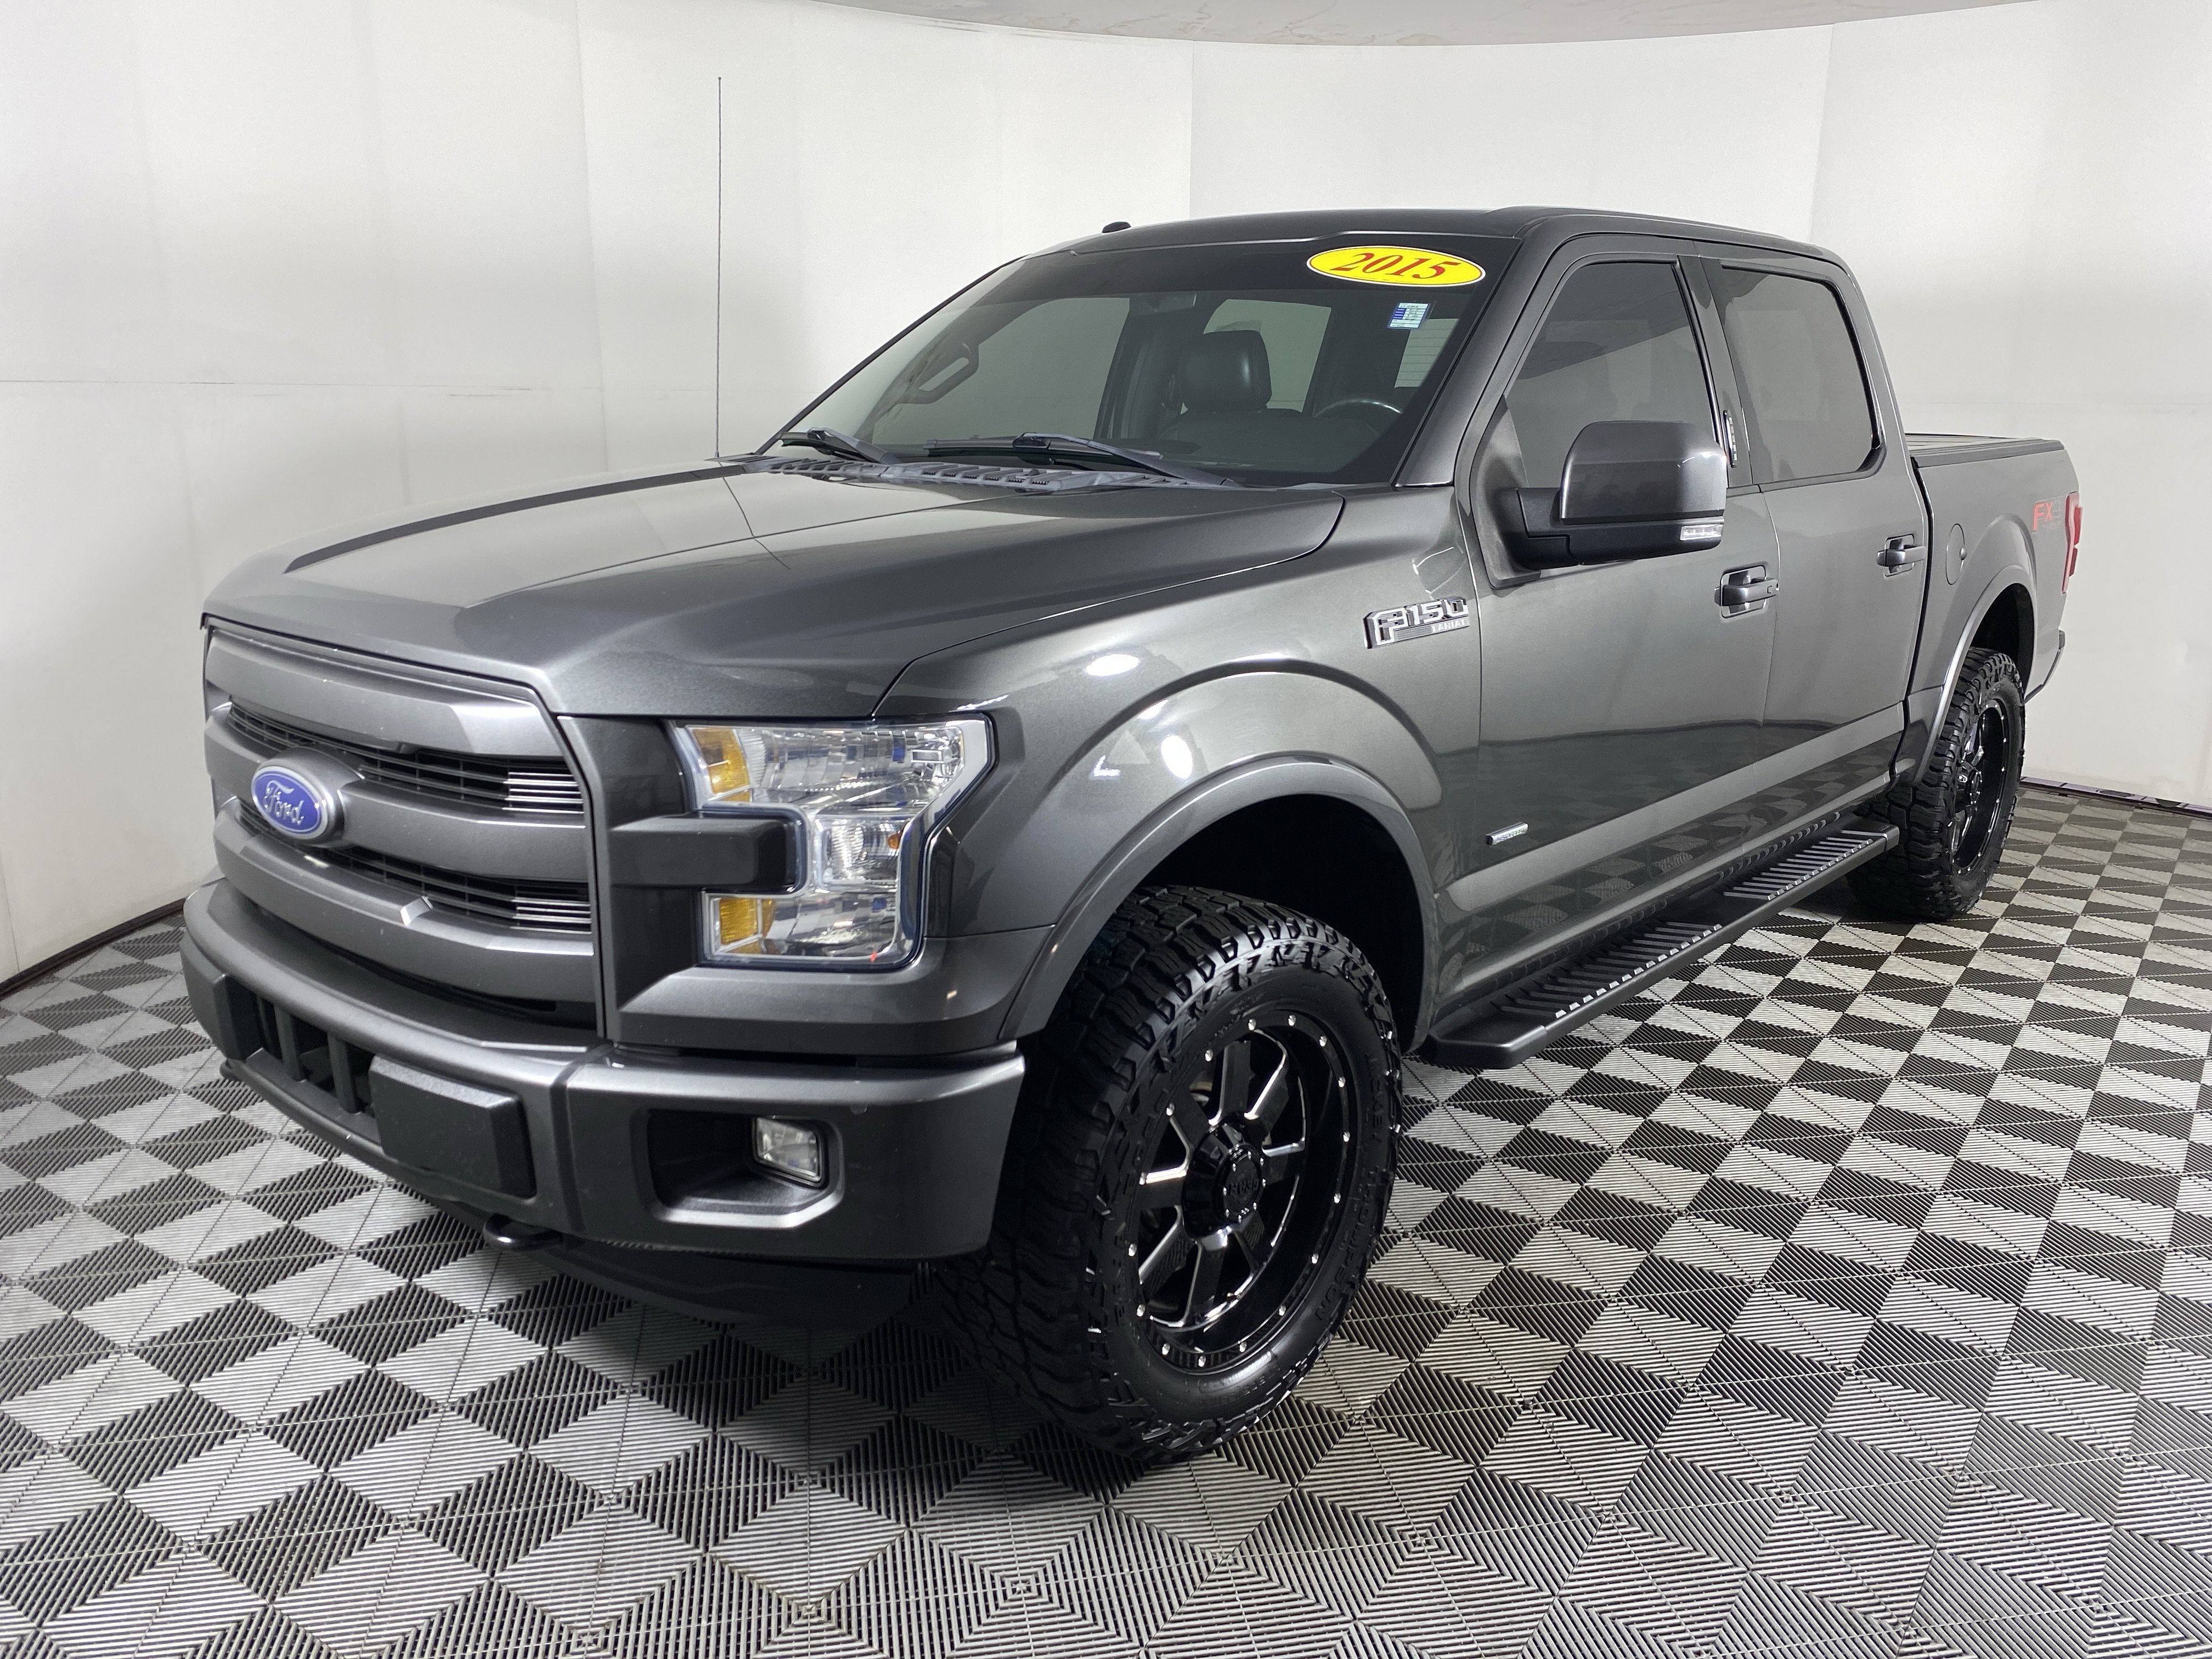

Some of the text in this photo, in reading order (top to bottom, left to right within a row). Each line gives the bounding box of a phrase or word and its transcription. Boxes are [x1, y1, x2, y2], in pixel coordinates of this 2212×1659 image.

[1329, 252, 1462, 279] 2015
[1430, 618, 1466, 633] LARIAT
[263, 780, 304, 825] Ford
